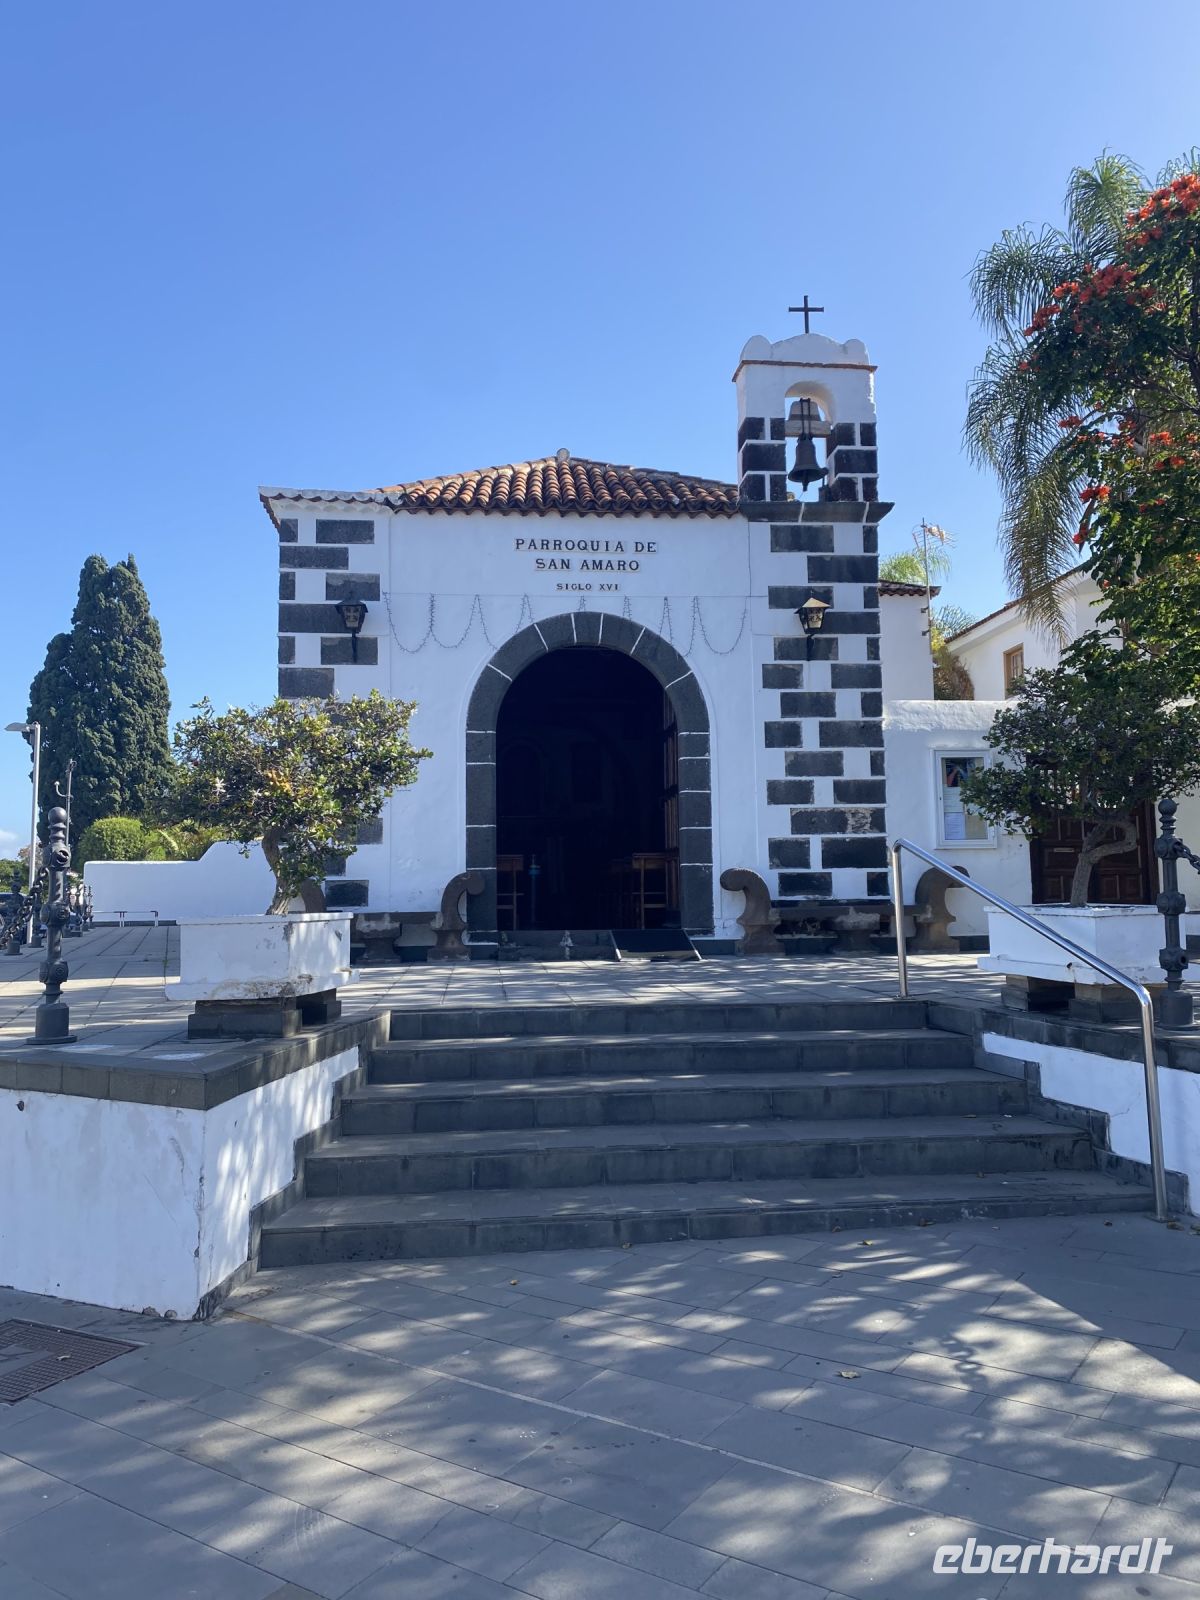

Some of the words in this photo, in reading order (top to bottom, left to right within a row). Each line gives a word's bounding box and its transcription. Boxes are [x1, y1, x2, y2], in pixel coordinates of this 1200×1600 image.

[515, 538, 625, 552] PARROQUIA
[634, 541, 657, 552] DE
[535, 558, 571, 570] SAN
[580, 559, 640, 571] AMARO
[556, 583, 592, 591] SIGLO
[599, 583, 619, 591] XVI
